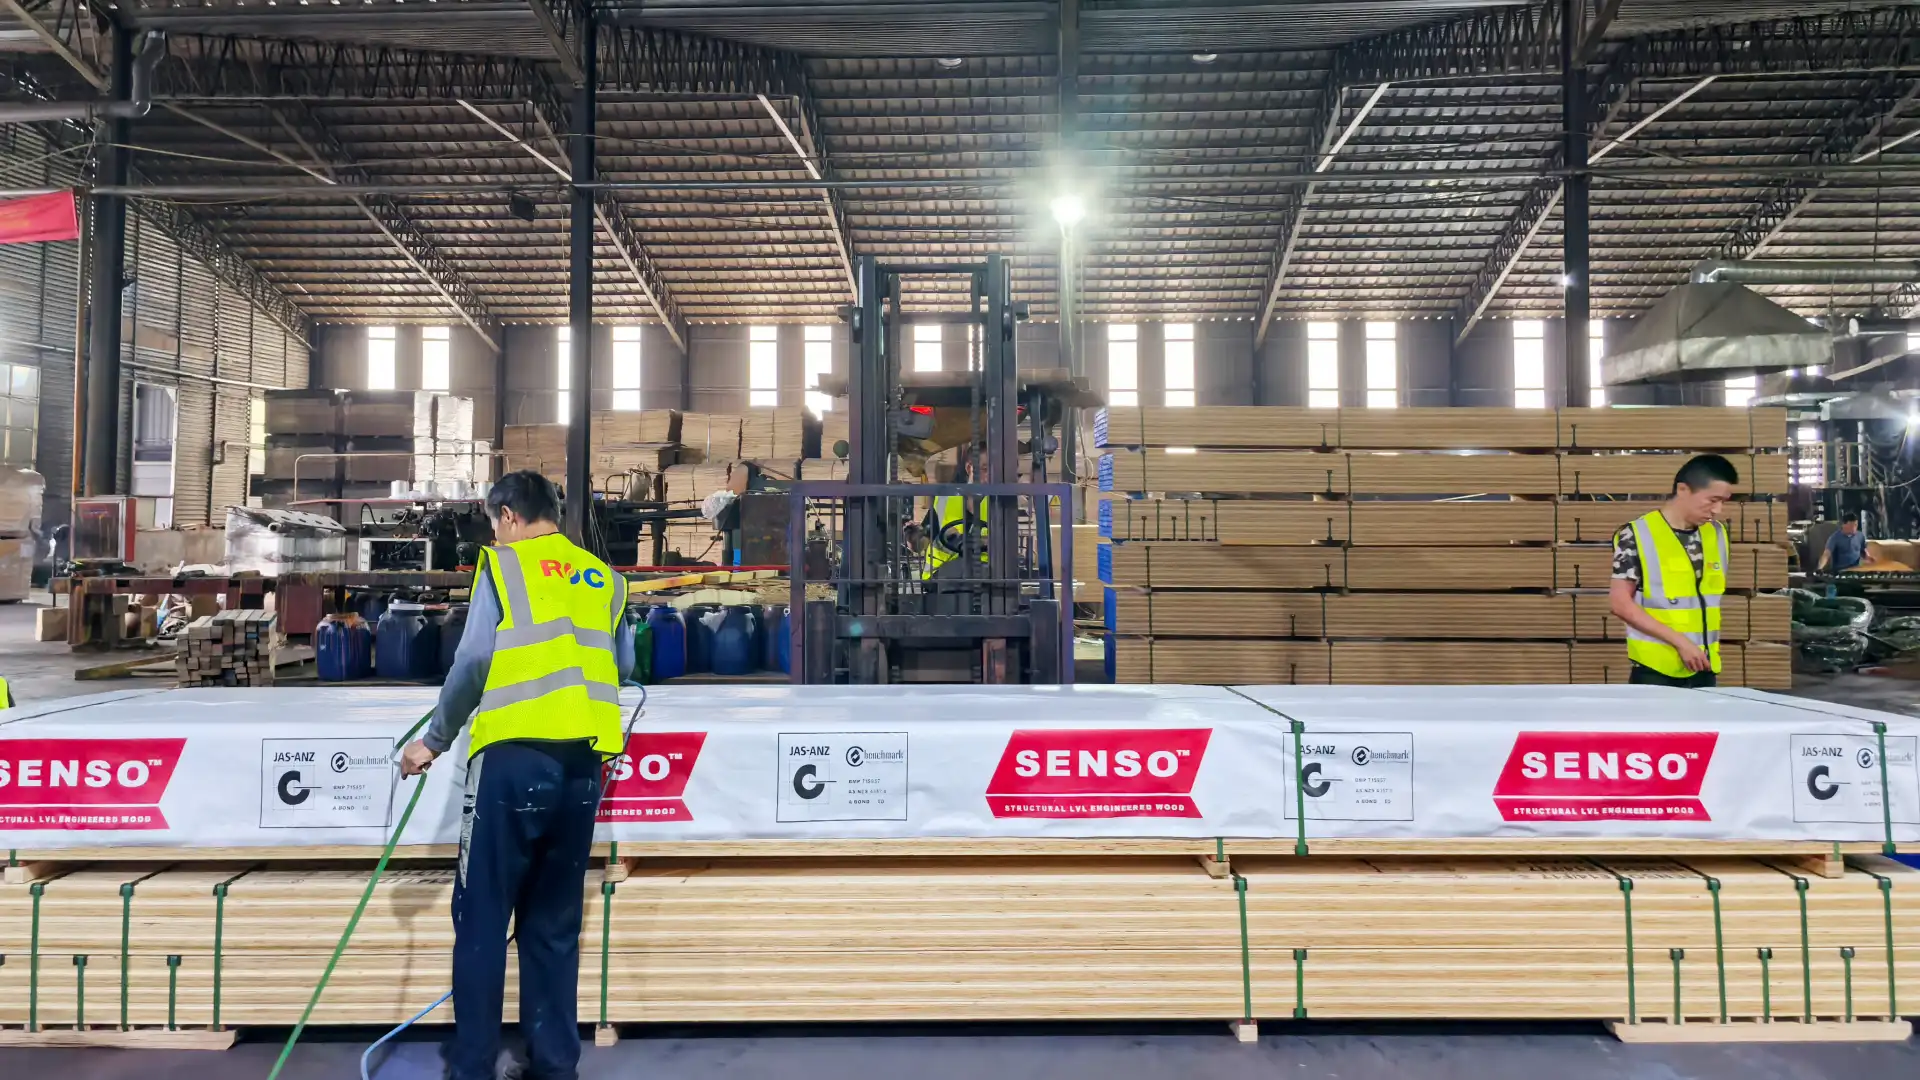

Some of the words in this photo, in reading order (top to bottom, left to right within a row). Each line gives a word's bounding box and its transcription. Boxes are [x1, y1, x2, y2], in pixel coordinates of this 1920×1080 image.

[789, 746, 830, 756] JAS-ANZ
[1299, 745, 1336, 755] AS-ANZ
[1802, 747, 1843, 757] JAS-ANZ
[273, 752, 315, 762] JAS-ANZ
[645, 808, 676, 816] WOOD
[1004, 804, 1066, 813] STRUCTURAL
[1069, 805, 1087, 813] LVL
[1090, 804, 1152, 813] ENGINEERED
[1155, 803, 1185, 812] WOOD
[1513, 807, 1577, 815] STRUCTURAL
[1580, 807, 1599, 815] LVL
[1602, 806, 1664, 815] ENGINEERED
[1666, 806, 1694, 814] WOOD
[39, 815, 56, 824] LVL
[58, 815, 118, 824] ENGINEERED
[121, 815, 152, 824] WOOD
